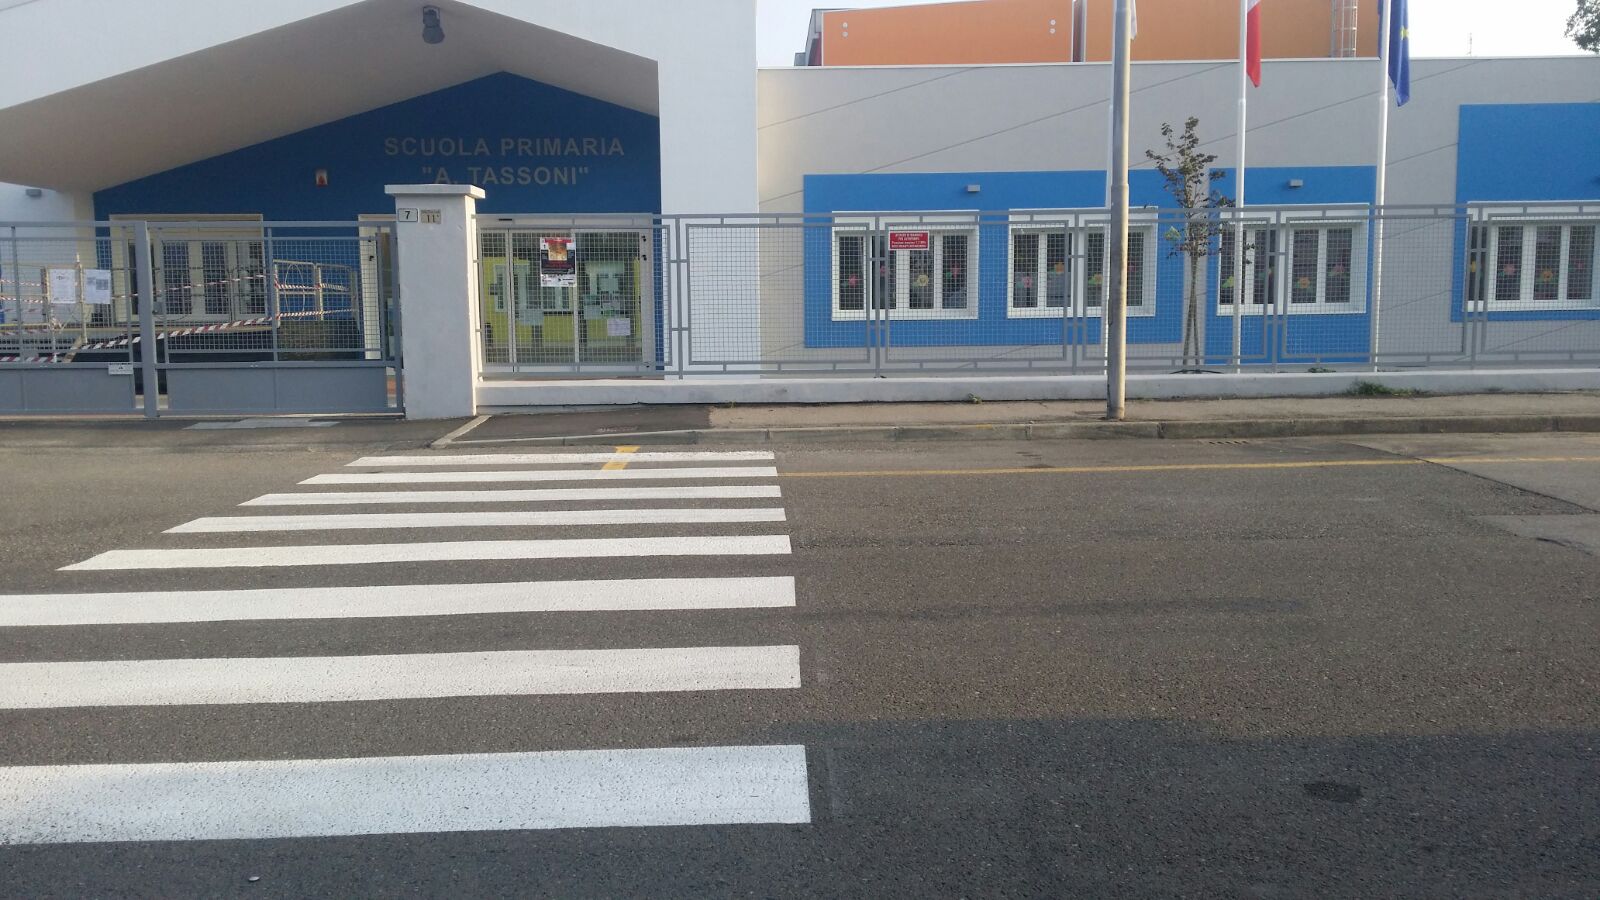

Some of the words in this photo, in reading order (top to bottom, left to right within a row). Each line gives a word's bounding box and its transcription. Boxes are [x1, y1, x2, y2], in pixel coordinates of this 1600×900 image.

[384, 137, 490, 156] SCUOLA
[500, 137, 625, 156] PRIMARIA
[467, 166, 589, 185] TASSONI"
[404, 210, 411, 220] 7
